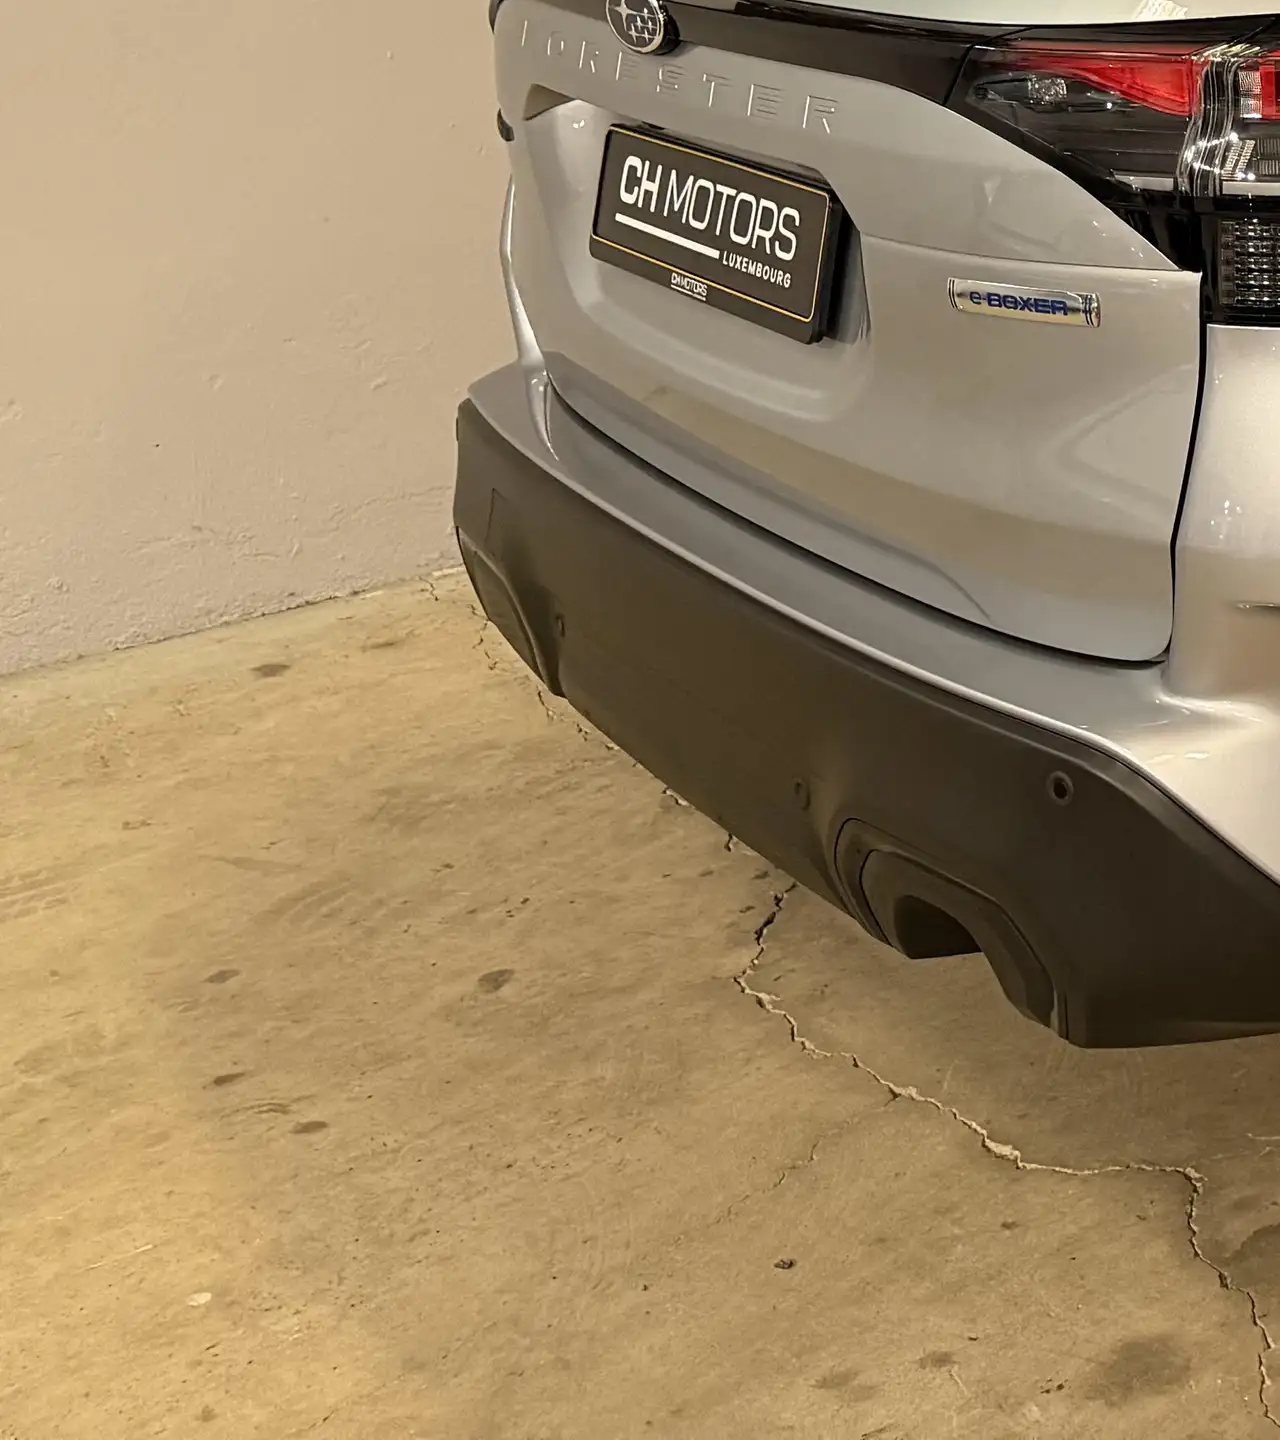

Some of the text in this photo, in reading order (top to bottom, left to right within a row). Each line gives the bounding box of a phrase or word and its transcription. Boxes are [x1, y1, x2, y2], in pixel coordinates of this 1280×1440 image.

[619, 155, 800, 261] CH MOTORS
[722, 250, 792, 288] LUXEMBOURG
[969, 291, 1069, 316] e-BOXER
